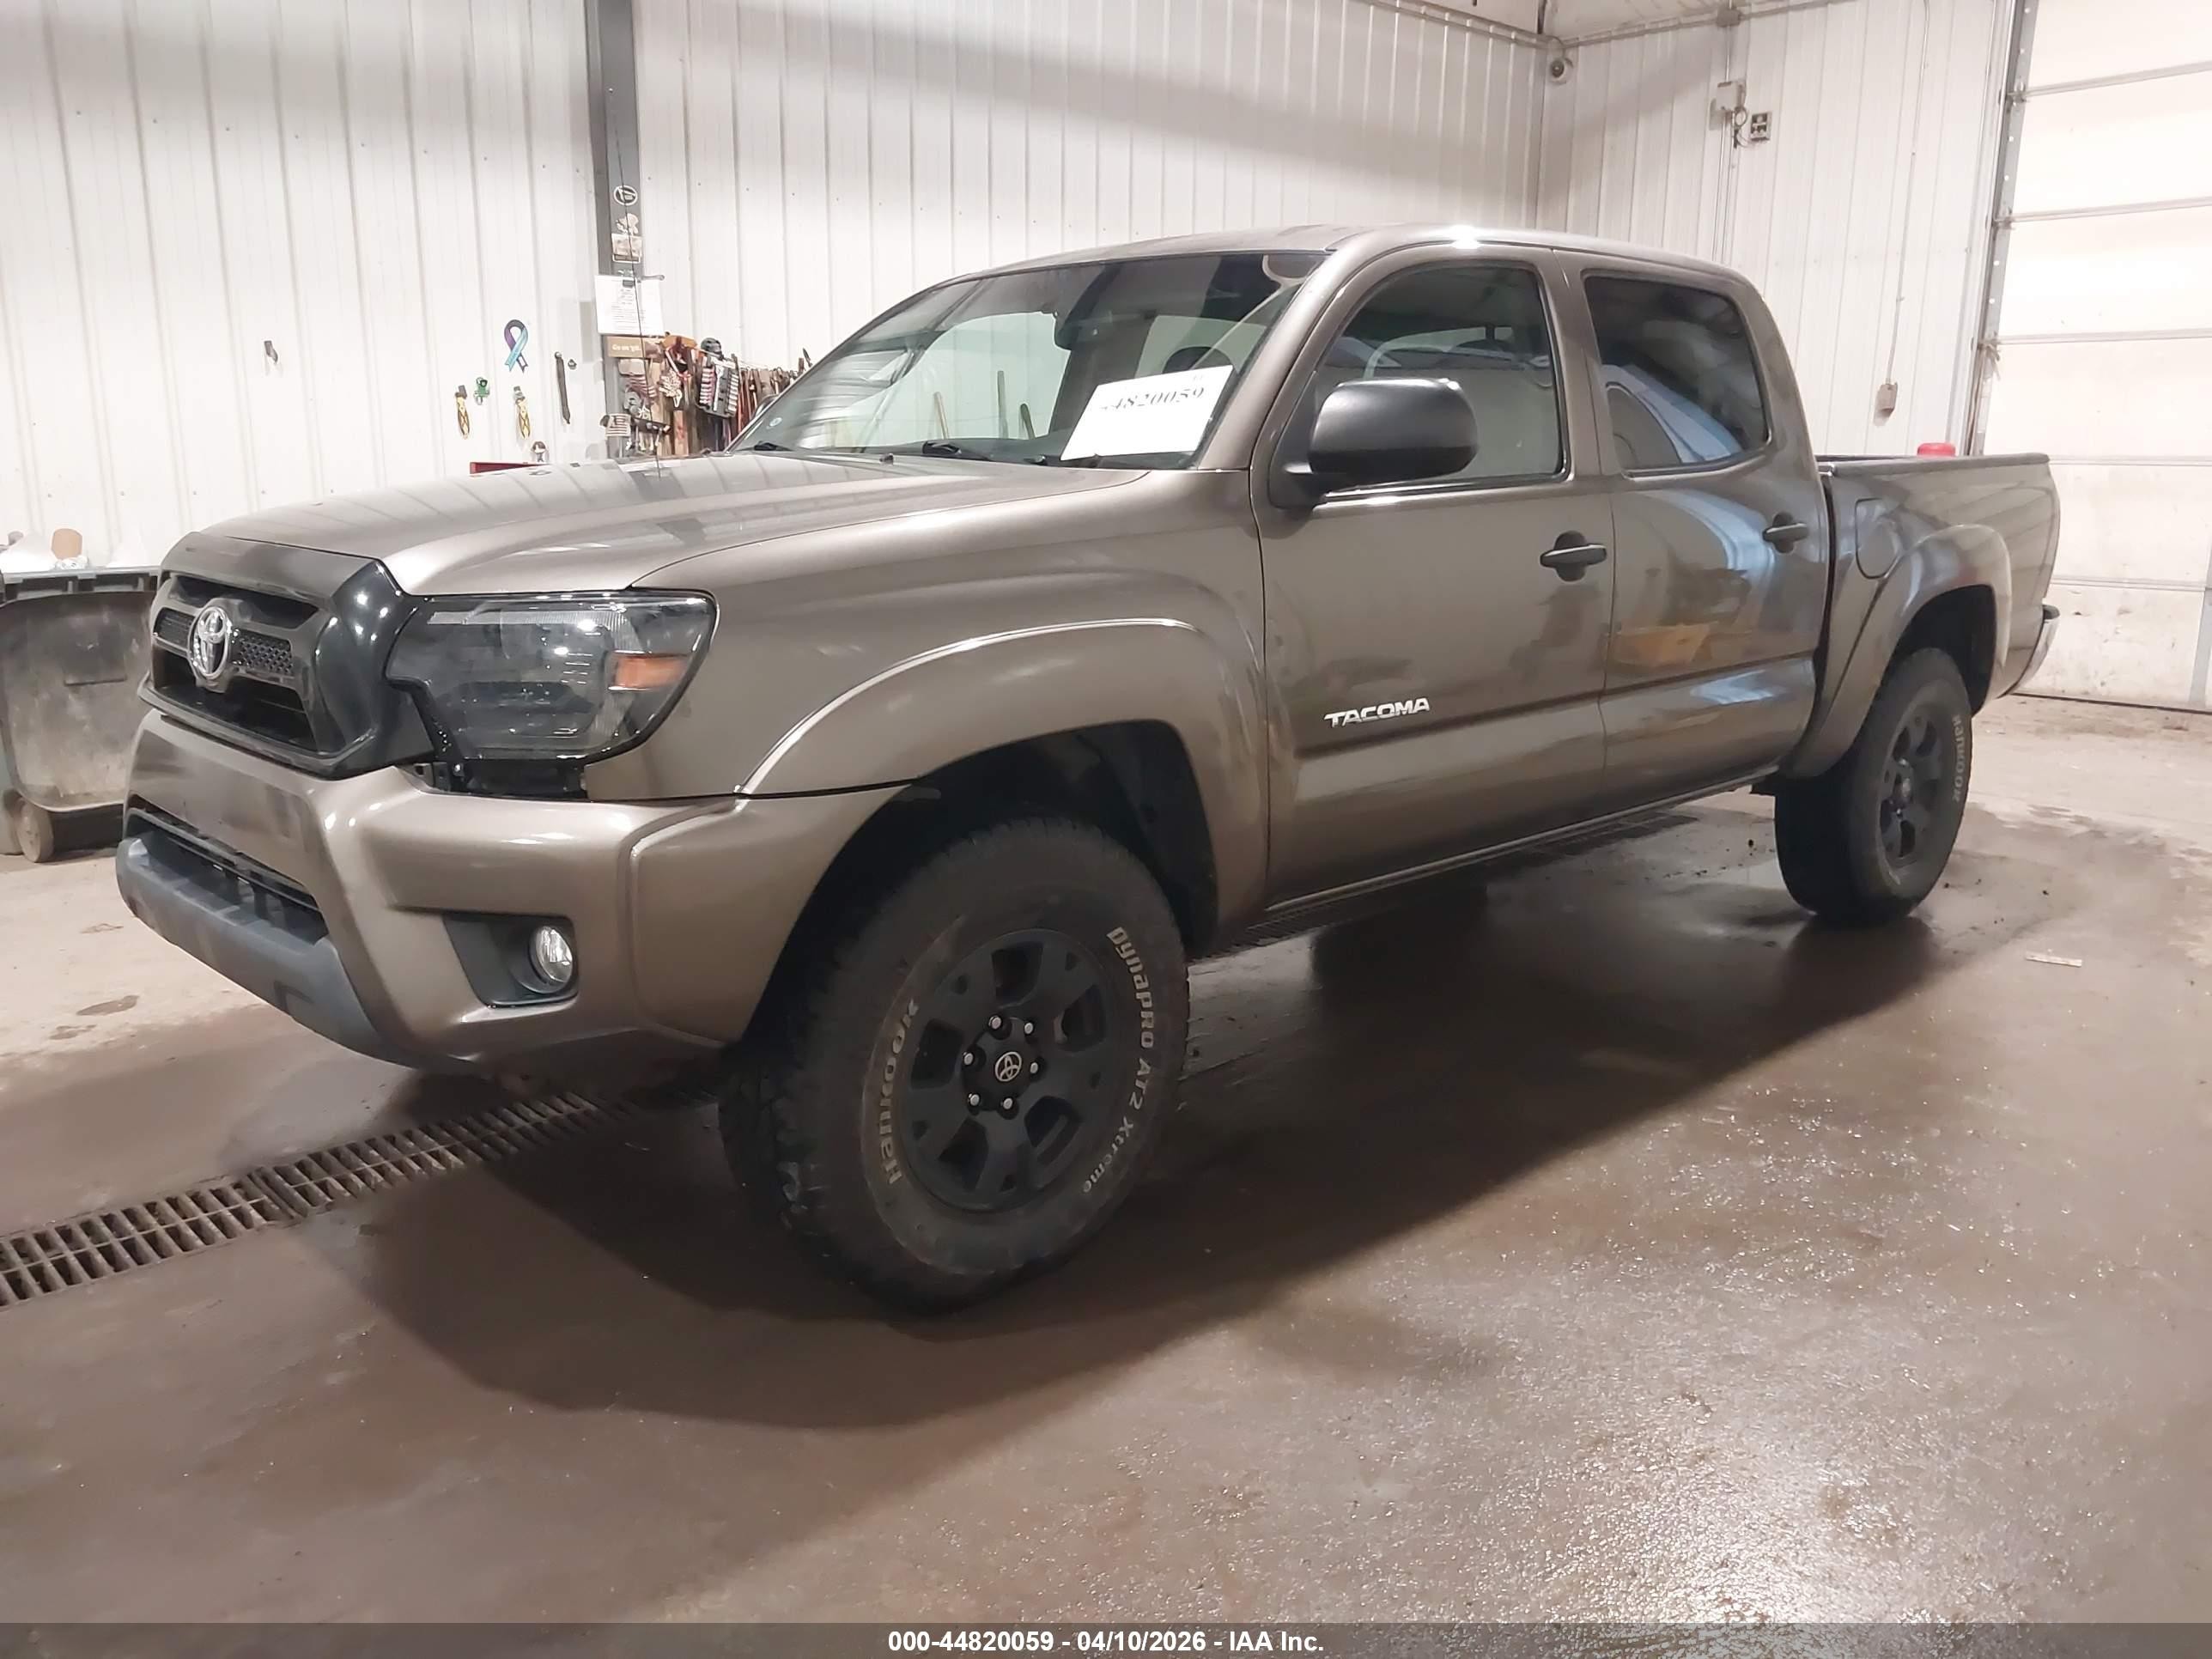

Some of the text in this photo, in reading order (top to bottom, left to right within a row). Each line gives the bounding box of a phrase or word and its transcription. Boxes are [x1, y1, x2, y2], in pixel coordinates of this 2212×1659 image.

[1100, 386, 1205, 410] 4820059
[1323, 697, 1431, 728] TACOMA
[1128, 1057, 1154, 1110] AT2
